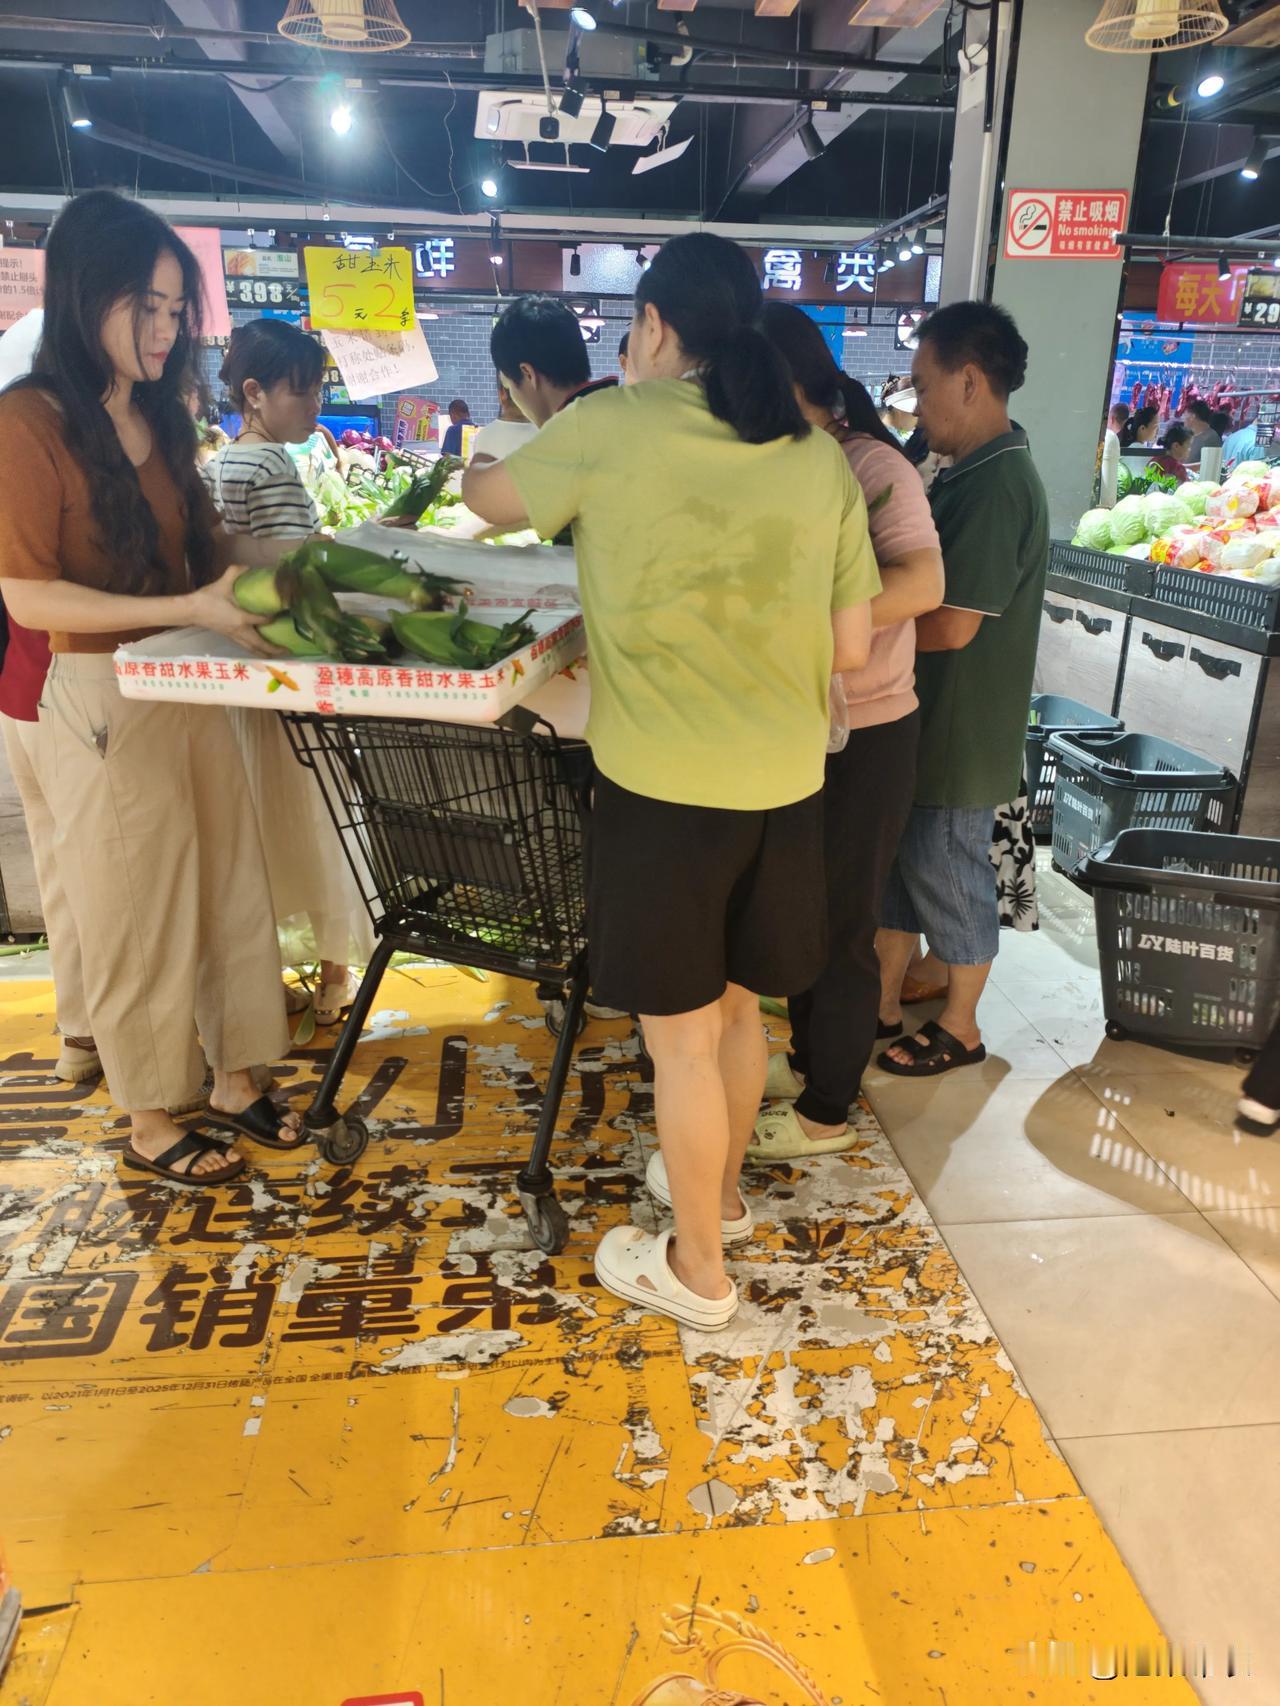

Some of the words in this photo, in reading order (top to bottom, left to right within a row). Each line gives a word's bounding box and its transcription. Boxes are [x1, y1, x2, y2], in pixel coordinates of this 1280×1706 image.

[1058, 200, 1120, 223] 禁止吸烟
[1058, 224, 1071, 235] No
[1073, 224, 1117, 239] smoking
[333, 254, 402, 281] 甜玉米
[0, 1253, 602, 1362] 国销量第
